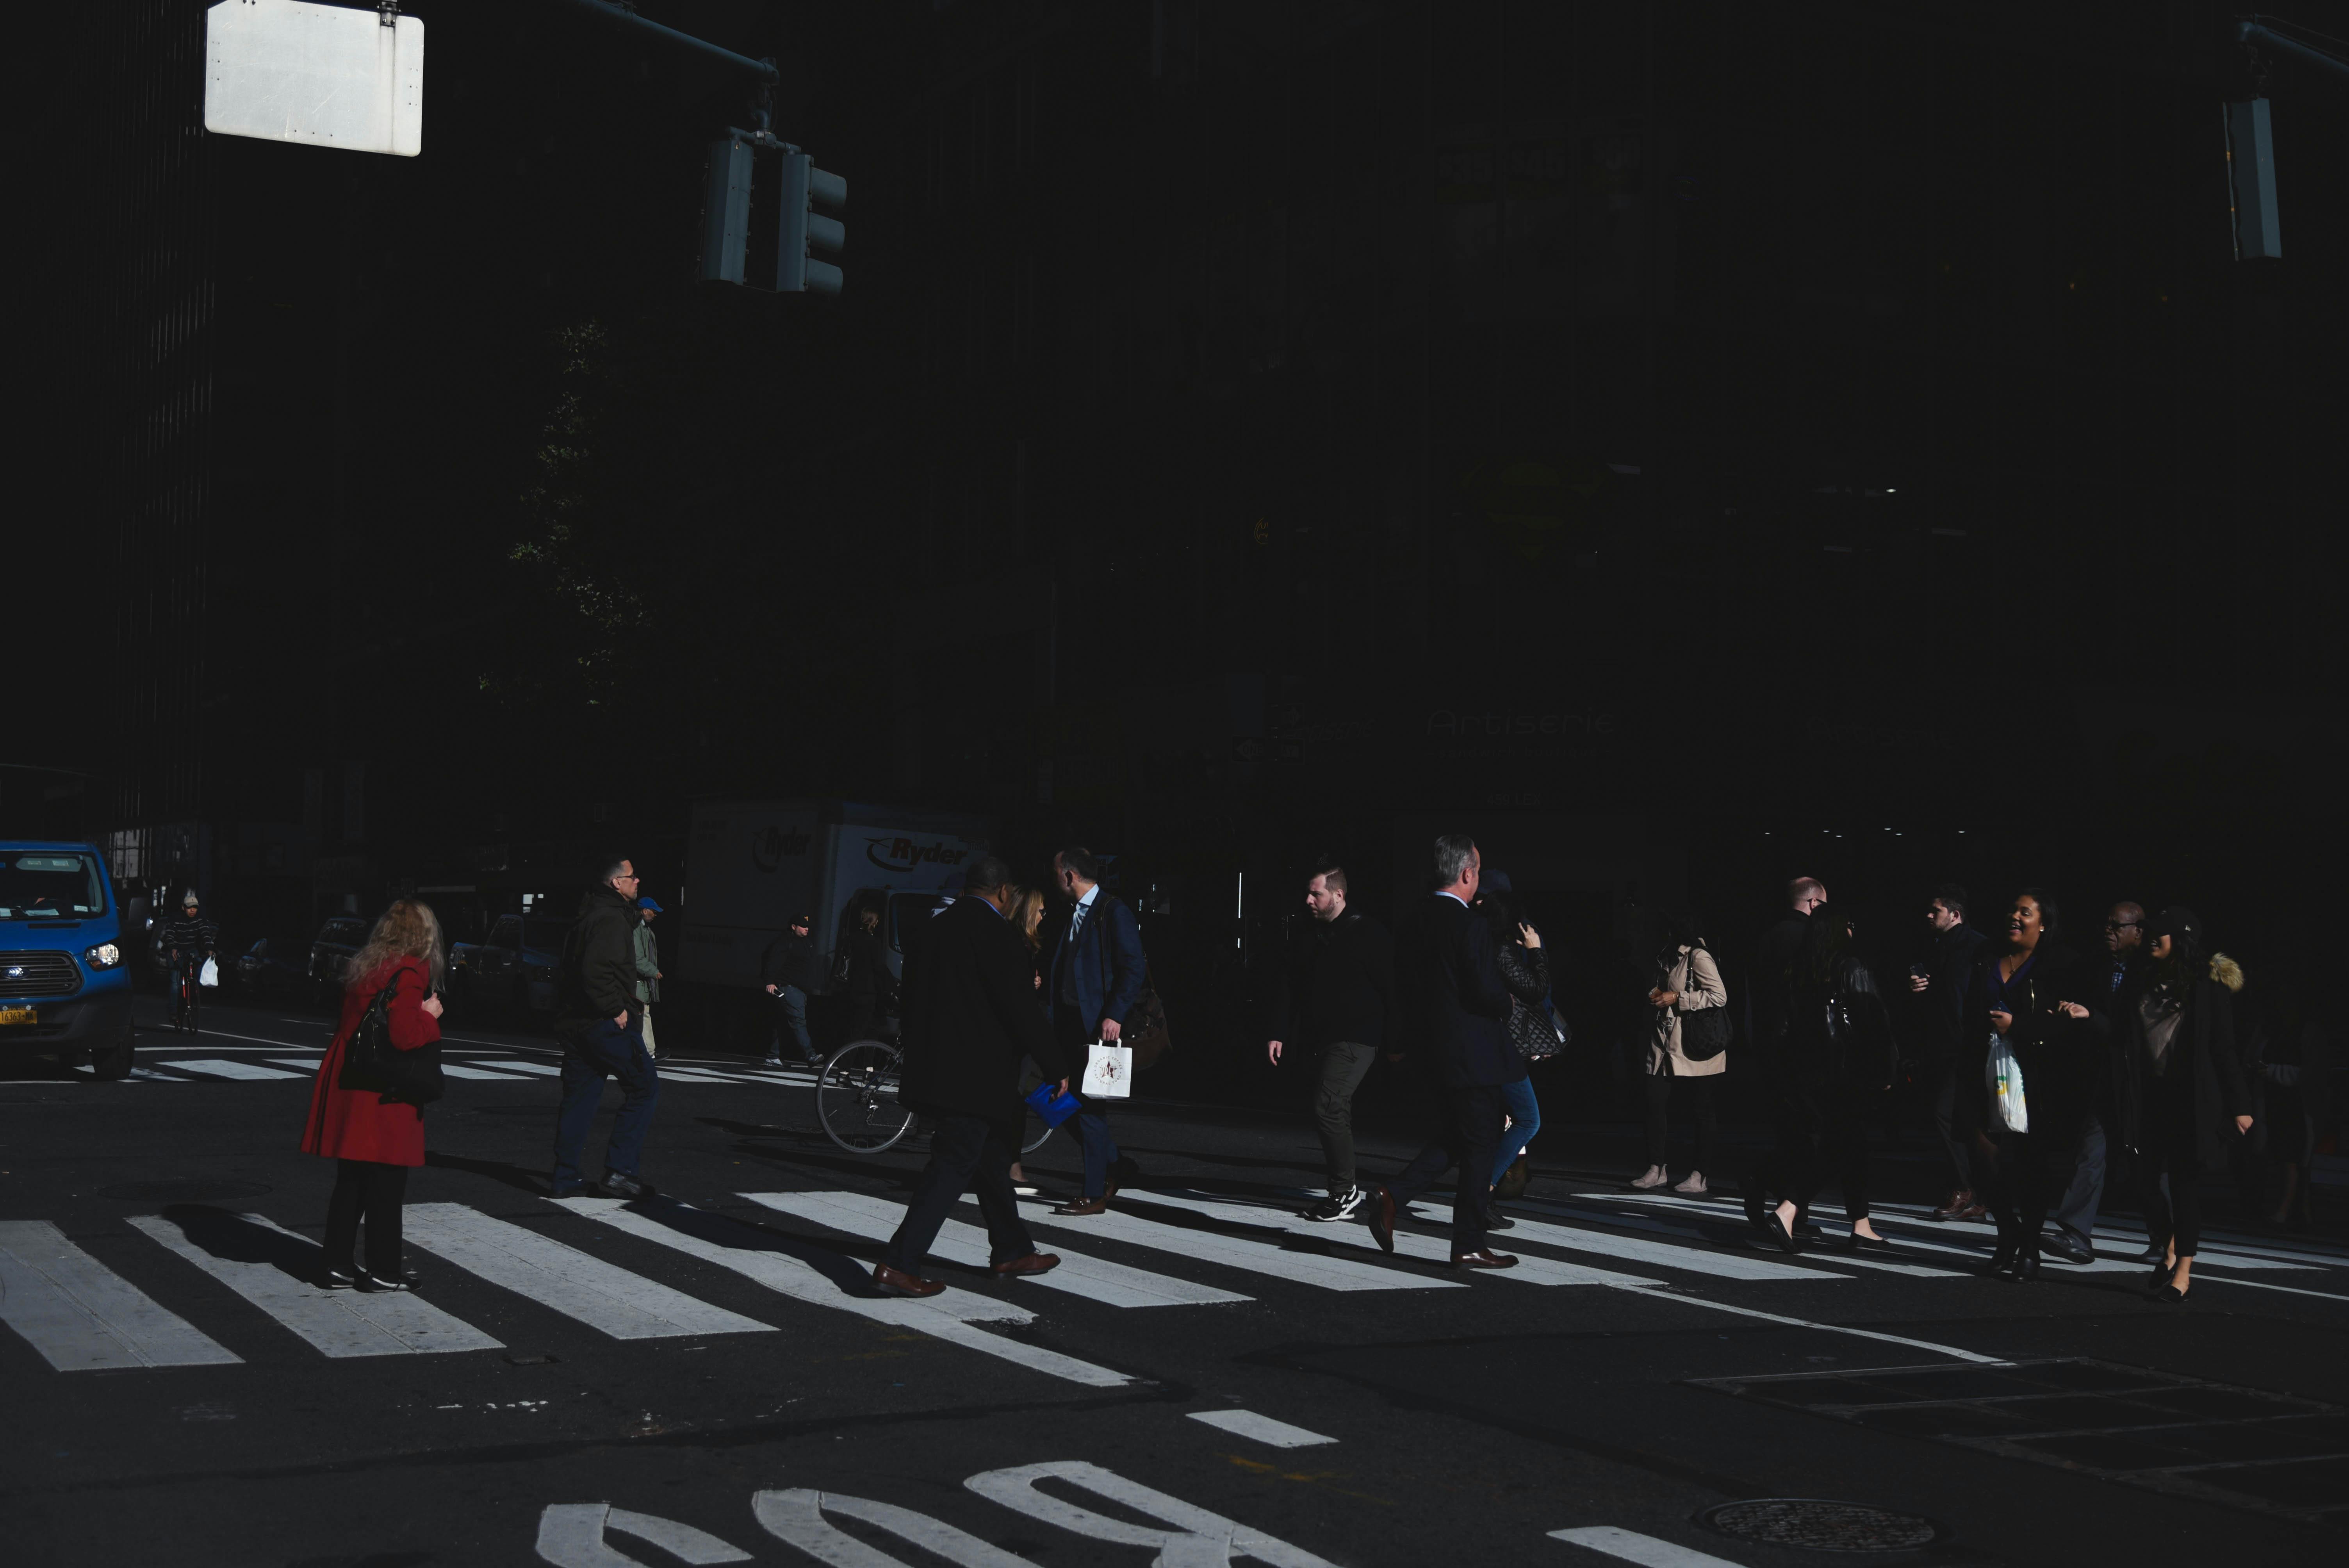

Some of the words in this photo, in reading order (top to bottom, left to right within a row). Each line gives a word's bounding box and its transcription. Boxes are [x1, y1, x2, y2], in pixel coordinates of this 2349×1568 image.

[1426, 706, 1615, 737] Artiserie
[764, 825, 812, 863] Ryder
[889, 837, 968, 866] Ryder
[1094, 1056, 1110, 1068] ORGANIC
[1112, 1057, 1123, 1069] COFFEE
[1100, 1065, 1115, 1076] PRET
[1112, 1075, 1121, 1084] FOOD
